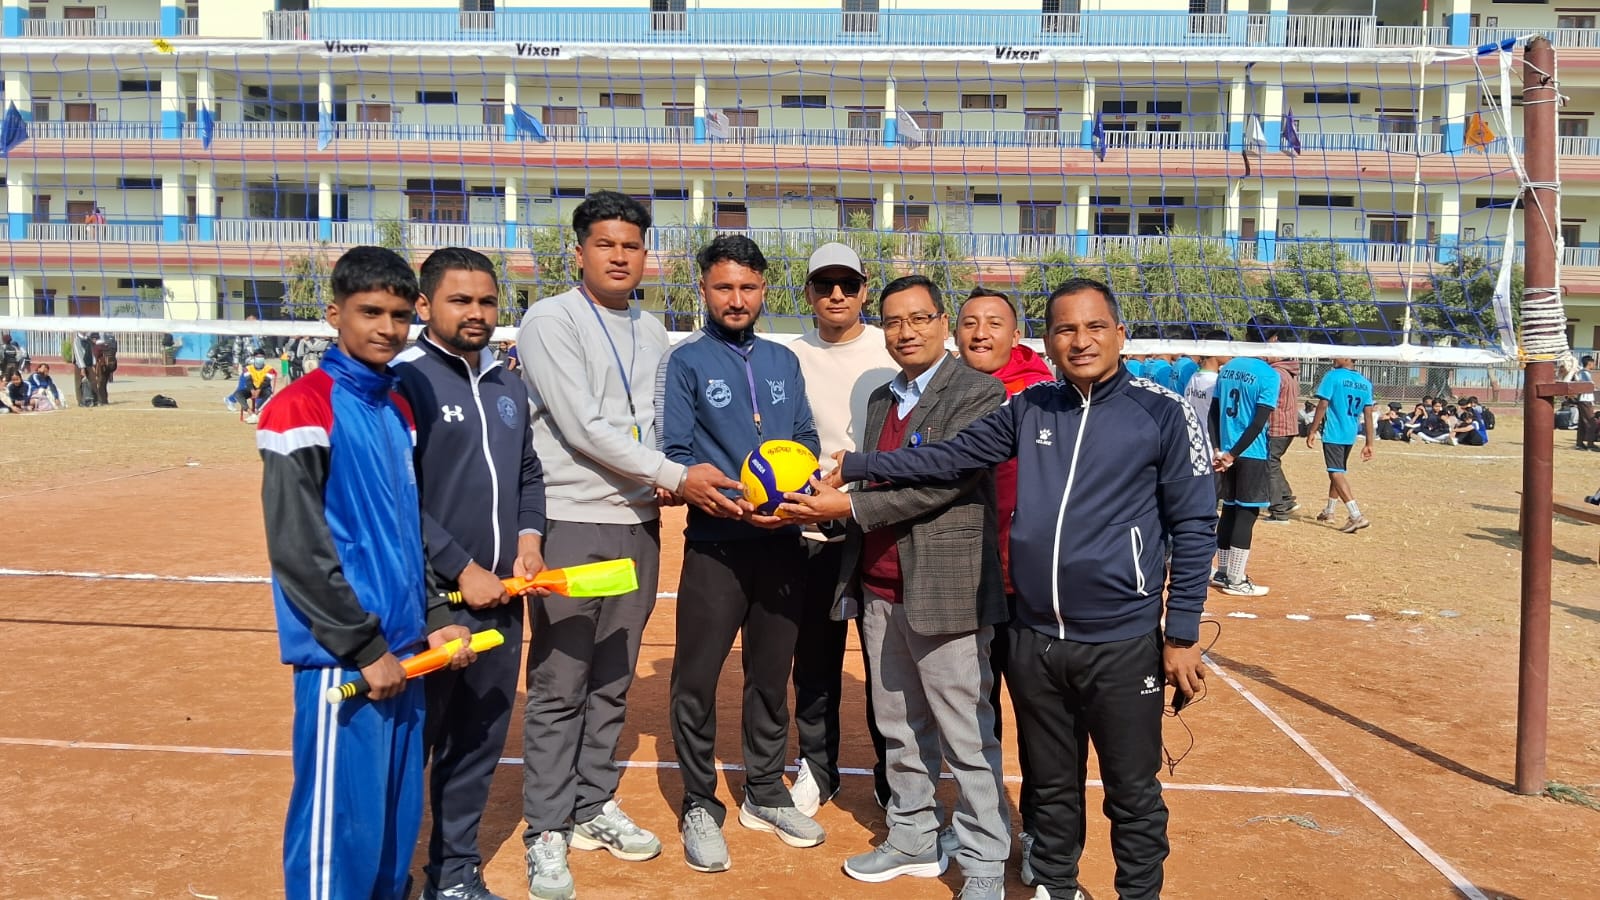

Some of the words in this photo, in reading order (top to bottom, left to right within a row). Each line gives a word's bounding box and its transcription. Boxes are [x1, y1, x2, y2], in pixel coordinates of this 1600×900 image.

[324, 40, 369, 53] Vixen
[515, 42, 561, 57] Vixen
[995, 46, 1040, 60] Vixen
[1234, 371, 1257, 385] SINGH
[1225, 388, 1240, 418] 3
